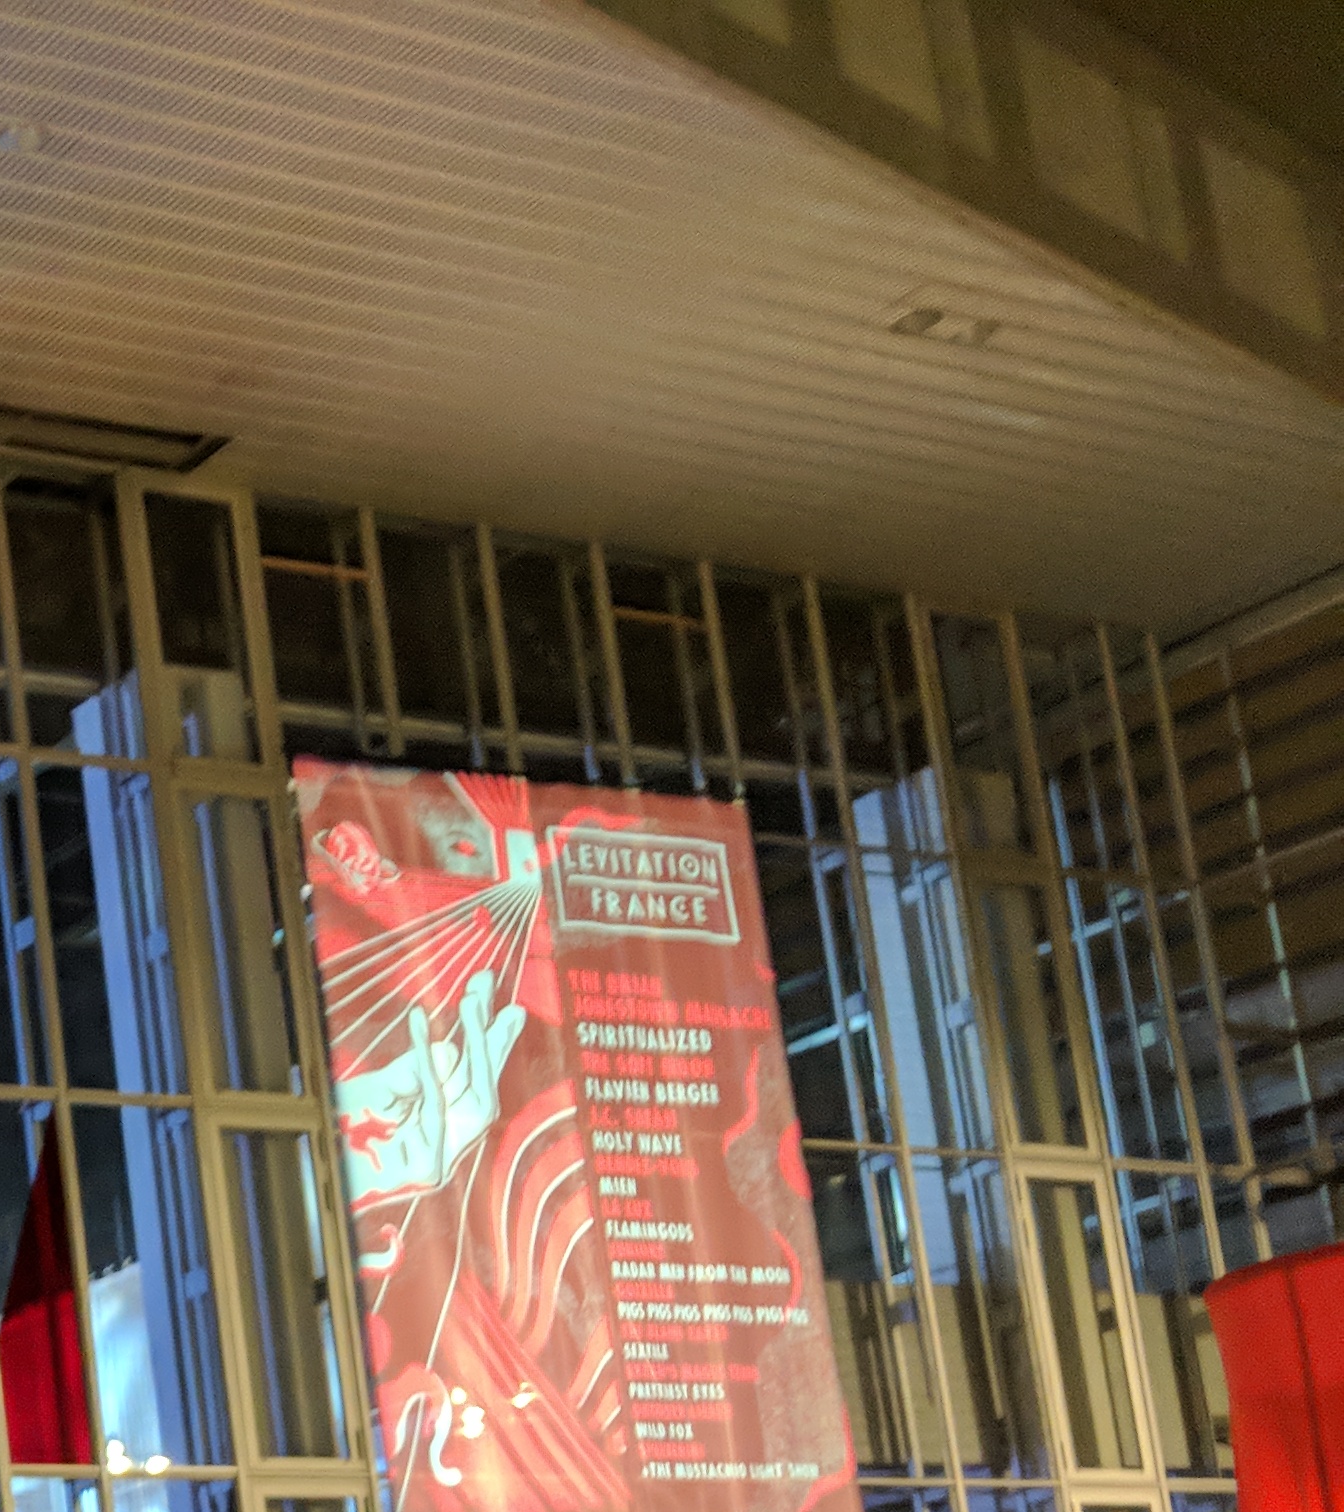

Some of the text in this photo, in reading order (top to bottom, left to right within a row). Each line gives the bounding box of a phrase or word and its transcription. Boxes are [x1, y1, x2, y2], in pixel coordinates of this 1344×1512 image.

[563, 844, 718, 884] LEVITATION
[591, 887, 708, 926] FRANCE
[576, 1021, 712, 1054] SPIRITUALIZED
[585, 1076, 720, 1106] FLAVIEN BERGER
[592, 1129, 683, 1155] HOLY WAVE
[600, 1175, 638, 1197] MIEN
[605, 1218, 695, 1243] FLAMINGODS
[611, 1260, 656, 1281] RADAR
[688, 1263, 729, 1284] FROM
[617, 1301, 645, 1320] PIGS
[647, 1303, 673, 1321] PIGS
[673, 1303, 701, 1322] PIGS
[703, 1303, 732, 1323] PIGS
[755, 1305, 785, 1324] PIGS
[692, 1382, 726, 1401] EYES
[634, 1421, 694, 1440] WILD FOX
